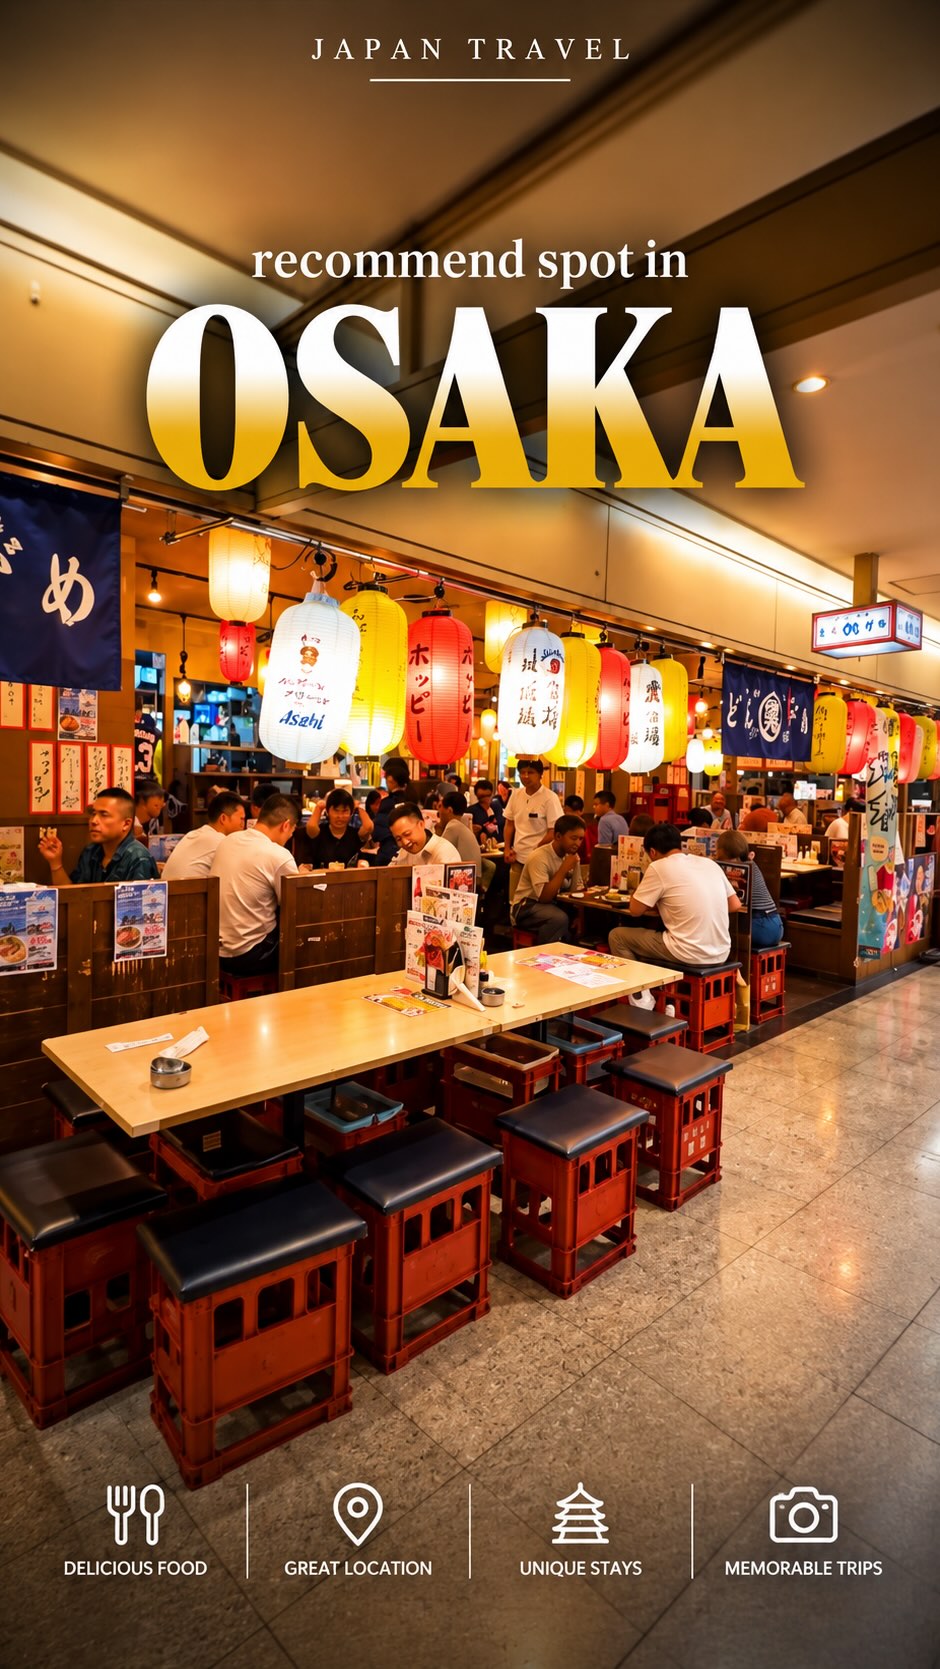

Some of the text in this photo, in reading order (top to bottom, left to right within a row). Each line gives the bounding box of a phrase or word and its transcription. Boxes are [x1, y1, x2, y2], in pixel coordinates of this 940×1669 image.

[408, 643, 431, 743] ホッピー
[279, 709, 327, 731] Asahi
[135, 742, 154, 773] 3
